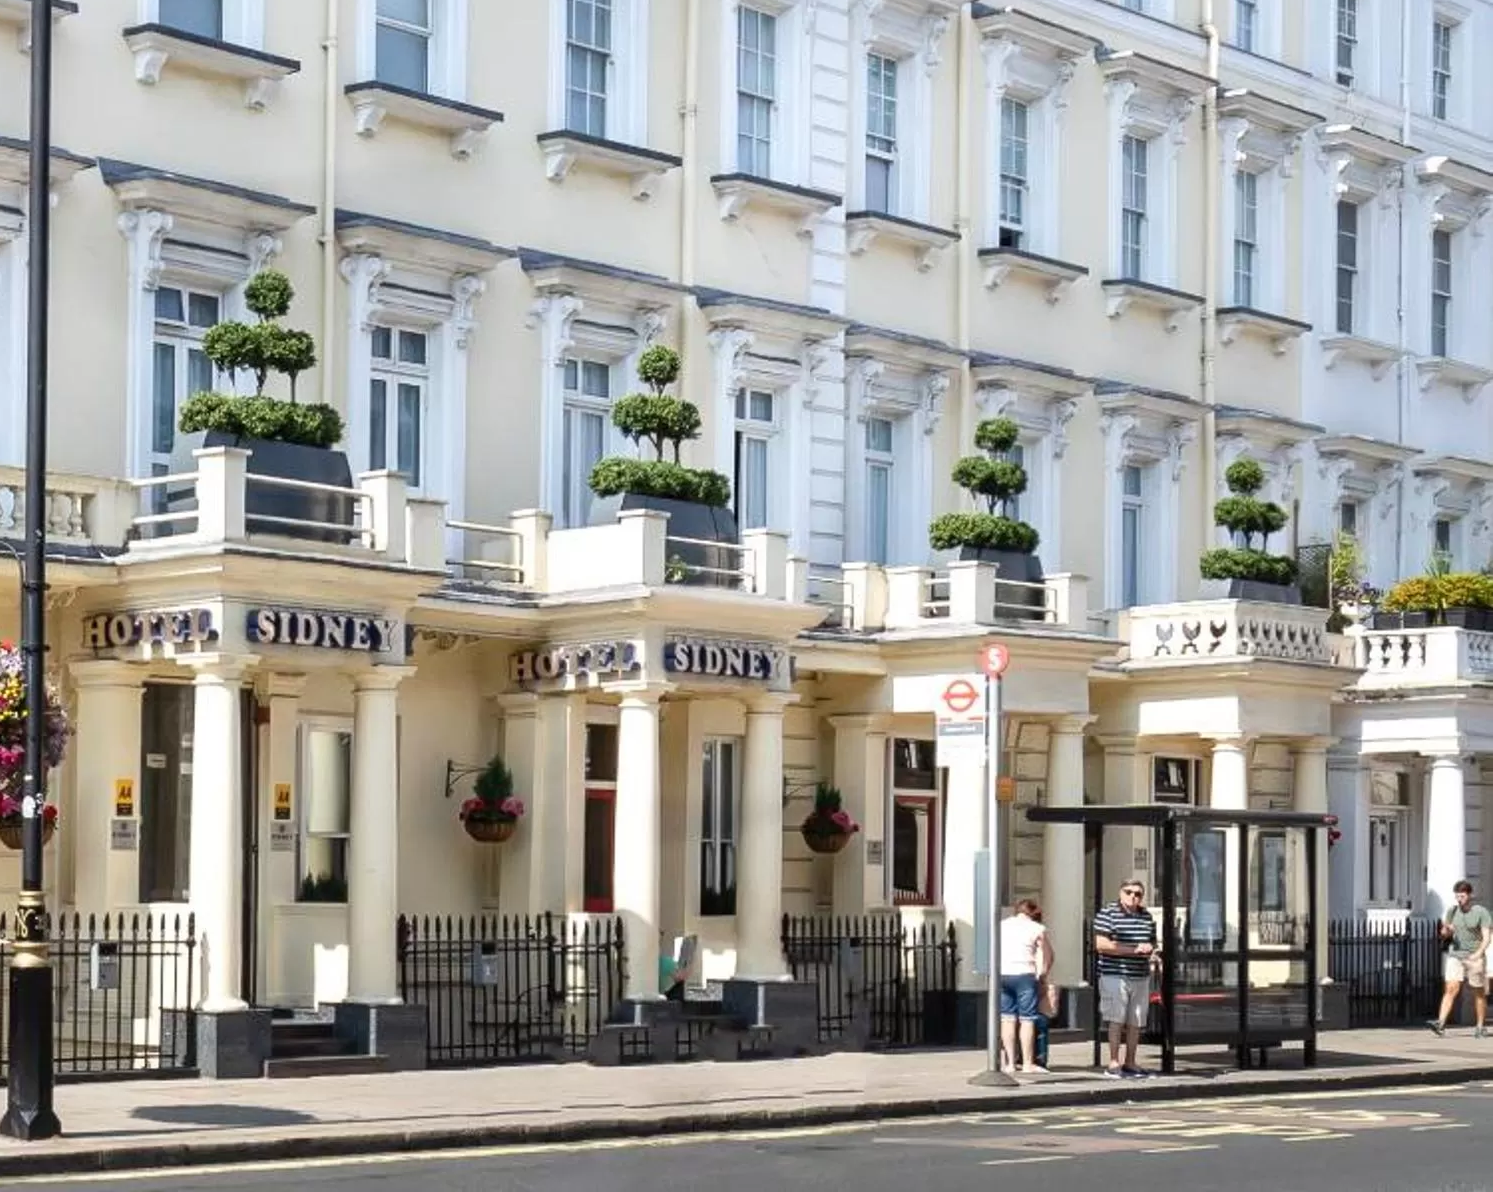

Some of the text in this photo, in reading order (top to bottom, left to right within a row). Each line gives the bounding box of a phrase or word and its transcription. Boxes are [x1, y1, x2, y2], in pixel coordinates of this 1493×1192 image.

[83, 608, 399, 651] HOTEL SIDNEY
[510, 642, 781, 682] HOTEL SIDNEY
